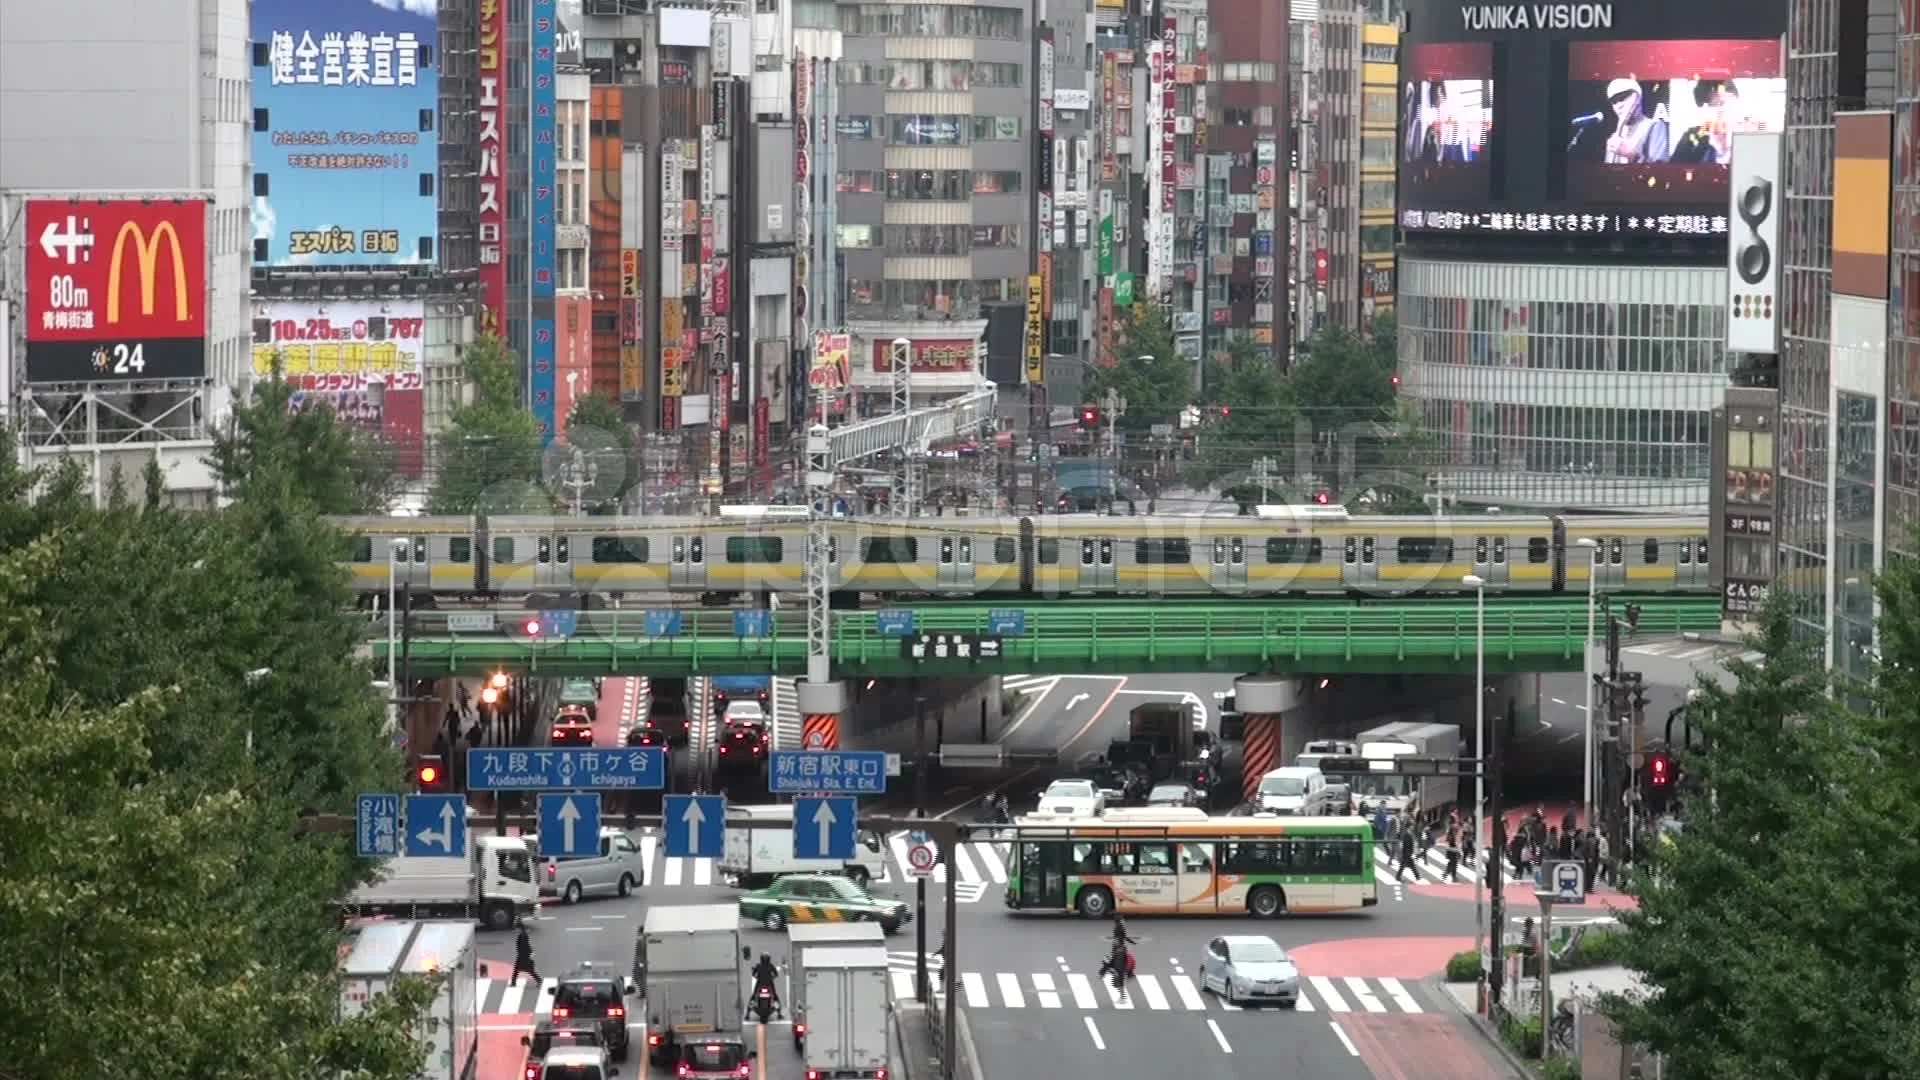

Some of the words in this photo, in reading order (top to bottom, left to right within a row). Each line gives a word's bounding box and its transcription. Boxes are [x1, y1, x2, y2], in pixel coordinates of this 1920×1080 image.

[1462, 5, 1528, 29] YUNIKA
[1534, 4, 1612, 28] VISION
[269, 30, 419, 86] 健全営業宣言
[289, 226, 355, 254] エスパス
[50, 275, 89, 308] 80m
[42, 310, 94, 330] 青梅街道
[113, 343, 146, 374] 24
[482, 752, 553, 773] 九段下
[487, 774, 549, 786] Kudanshita
